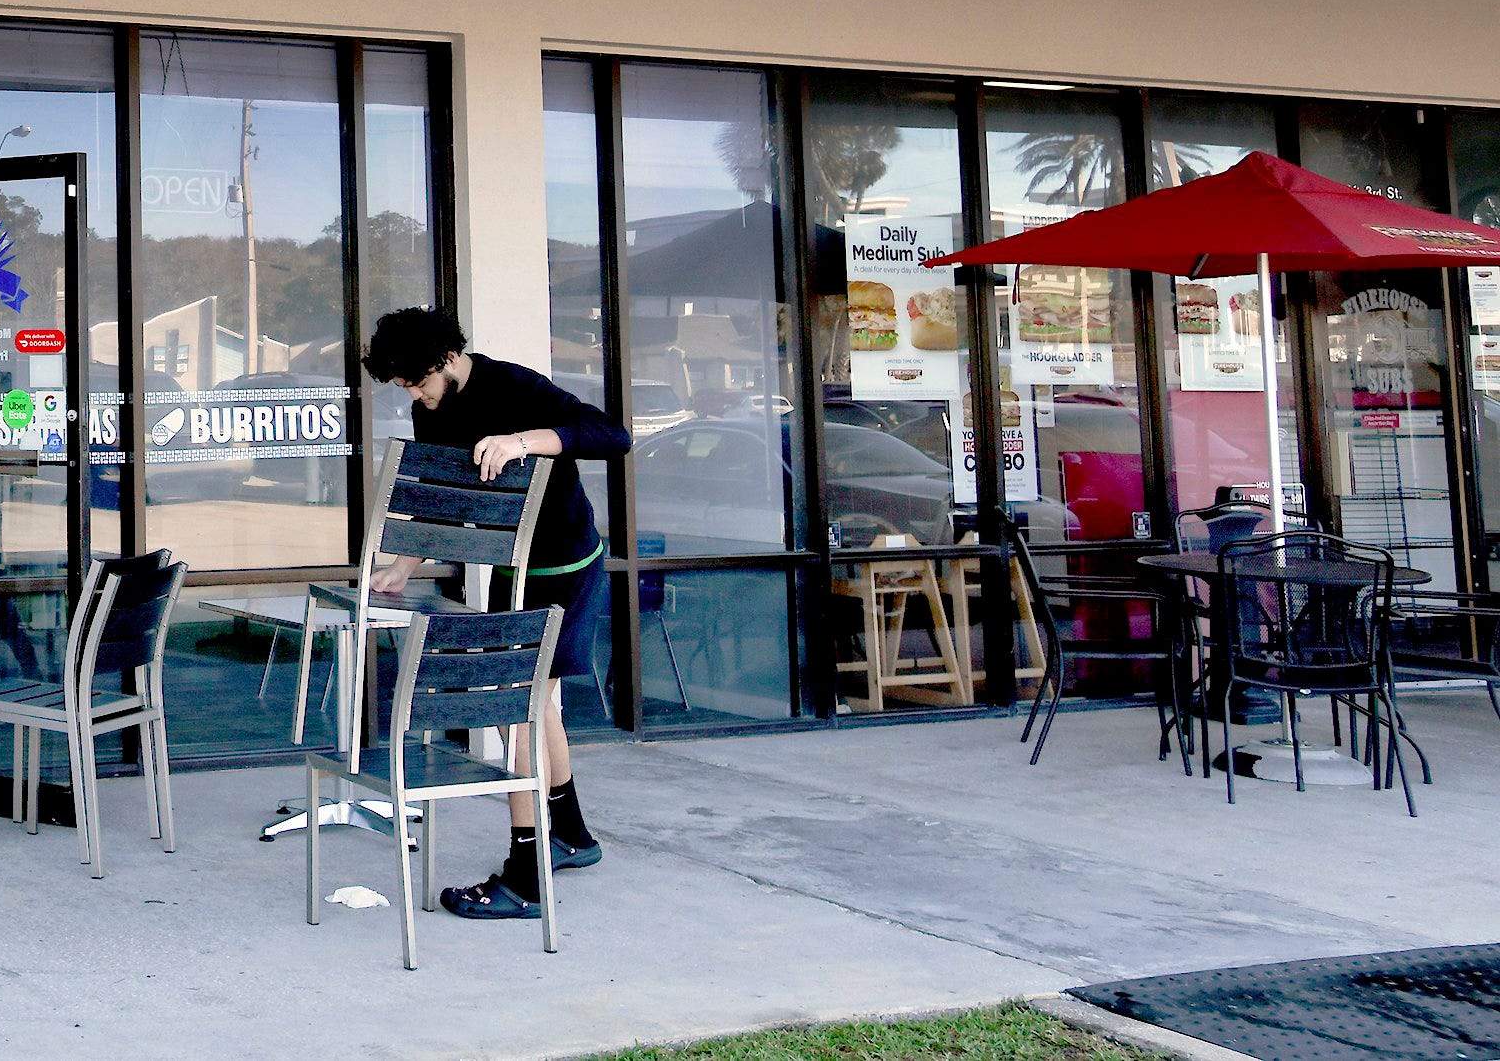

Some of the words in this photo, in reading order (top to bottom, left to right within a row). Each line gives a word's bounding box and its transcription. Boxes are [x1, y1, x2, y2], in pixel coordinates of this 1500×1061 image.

[141, 175, 221, 205] OPEN
[1387, 186, 1403, 199] St.
[880, 226, 917, 245] Daily
[852, 245, 913, 261] Medium
[883, 267, 900, 275] every
[901, 267, 912, 275] day
[1367, 368, 1414, 393] SUBS
[9, 402, 26, 410] Uber
[9, 411, 26, 419] Eats
[189, 403, 341, 443] BURRITOS
[1256, 481, 1270, 489] HOU
